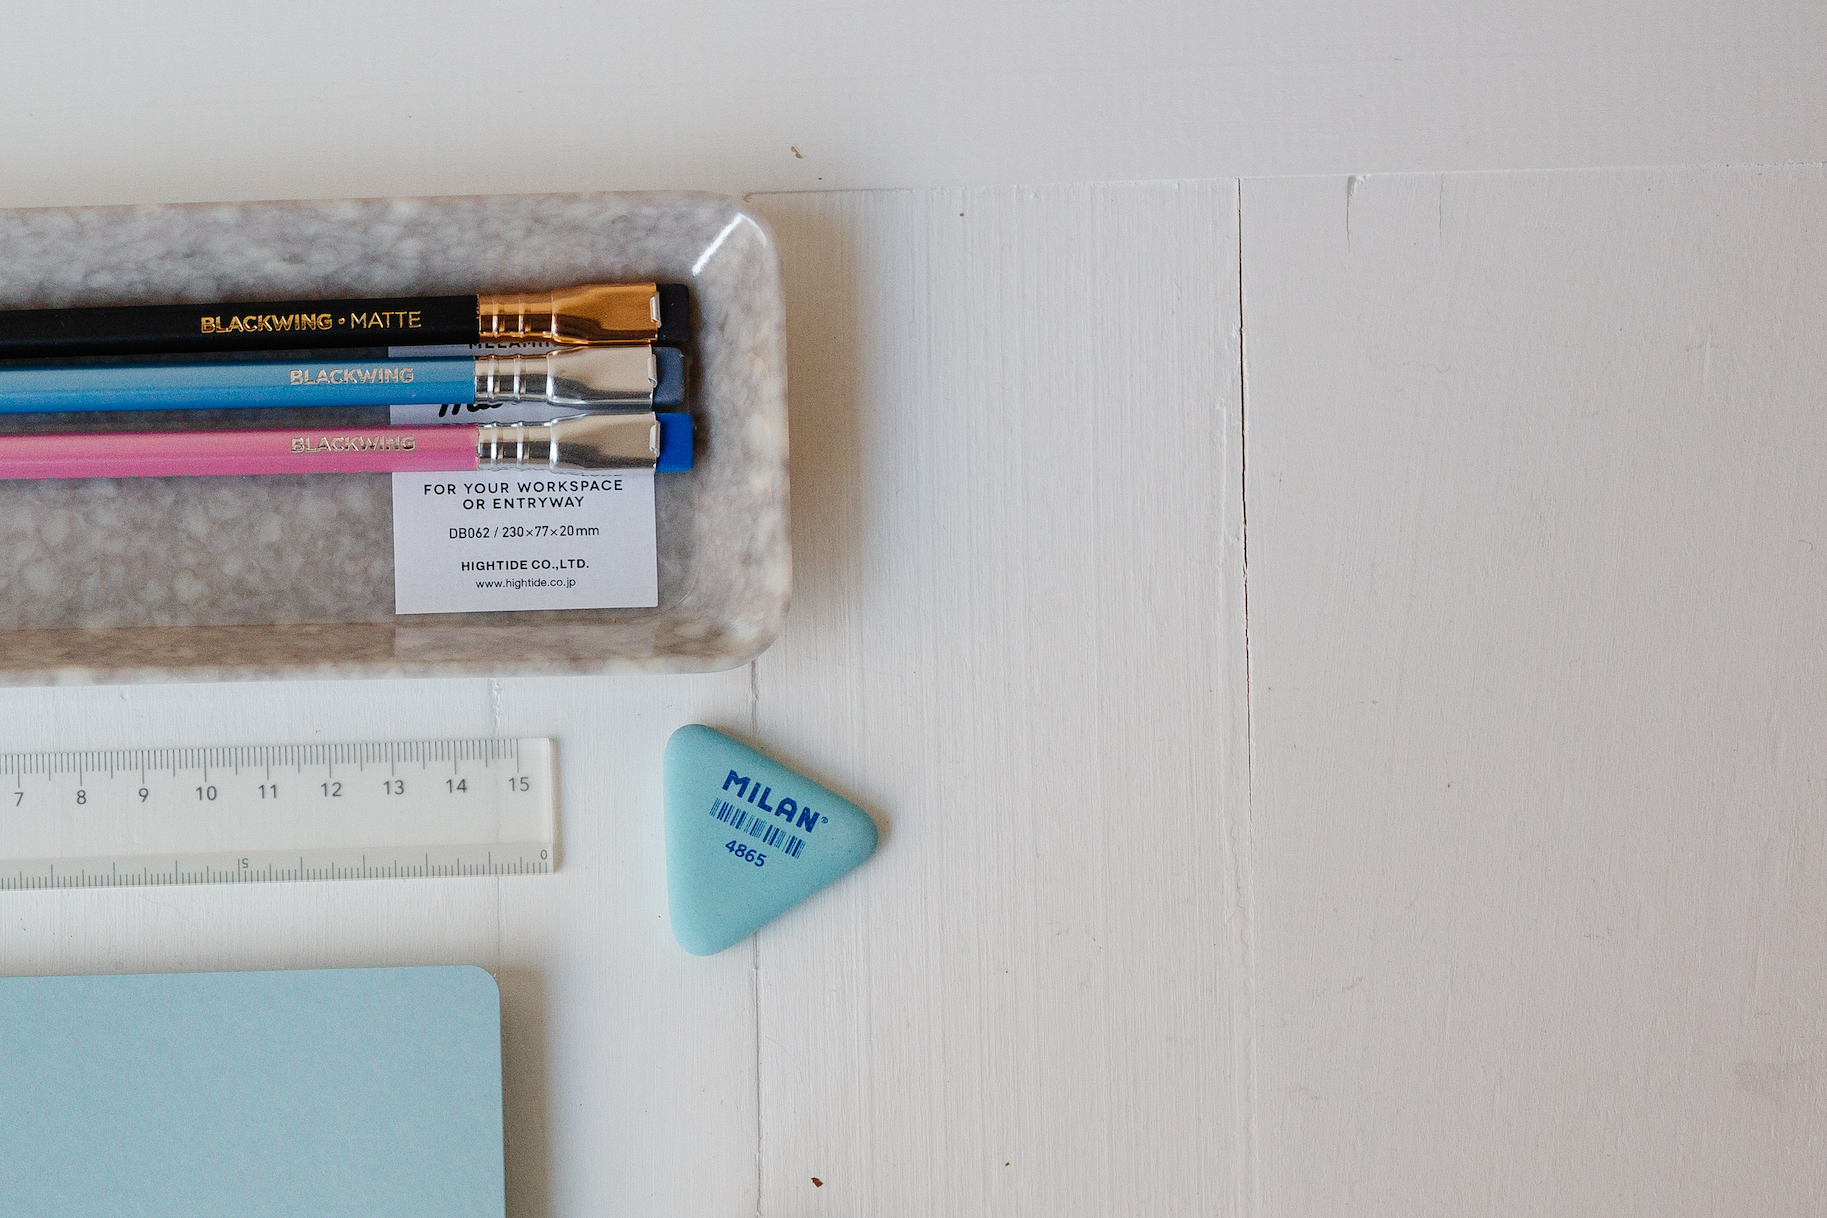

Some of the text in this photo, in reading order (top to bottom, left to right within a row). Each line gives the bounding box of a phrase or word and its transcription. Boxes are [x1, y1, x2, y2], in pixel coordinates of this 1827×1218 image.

[200, 310, 422, 334] BLACKWING MATTE
[289, 367, 415, 386] BLACKWING
[290, 436, 417, 454] BLACKWING
[424, 479, 624, 496] FOR YOUR WORKSPACE
[462, 496, 585, 510] OR ENTRYWAY
[449, 527, 490, 540] DB062
[461, 559, 589, 571] HIGHTIDE CO.,LTD.
[475, 578, 576, 589] www.hightide.co.jp
[14, 792, 24, 807] 7
[77, 790, 86, 805] 8
[138, 788, 149, 803] 9
[196, 786, 217, 801] 10
[259, 784, 277, 799] 11
[321, 782, 342, 797] 12
[383, 780, 404, 795] 13
[446, 779, 468, 793] 14
[509, 777, 529, 792] 15
[725, 840, 767, 867] 4865
